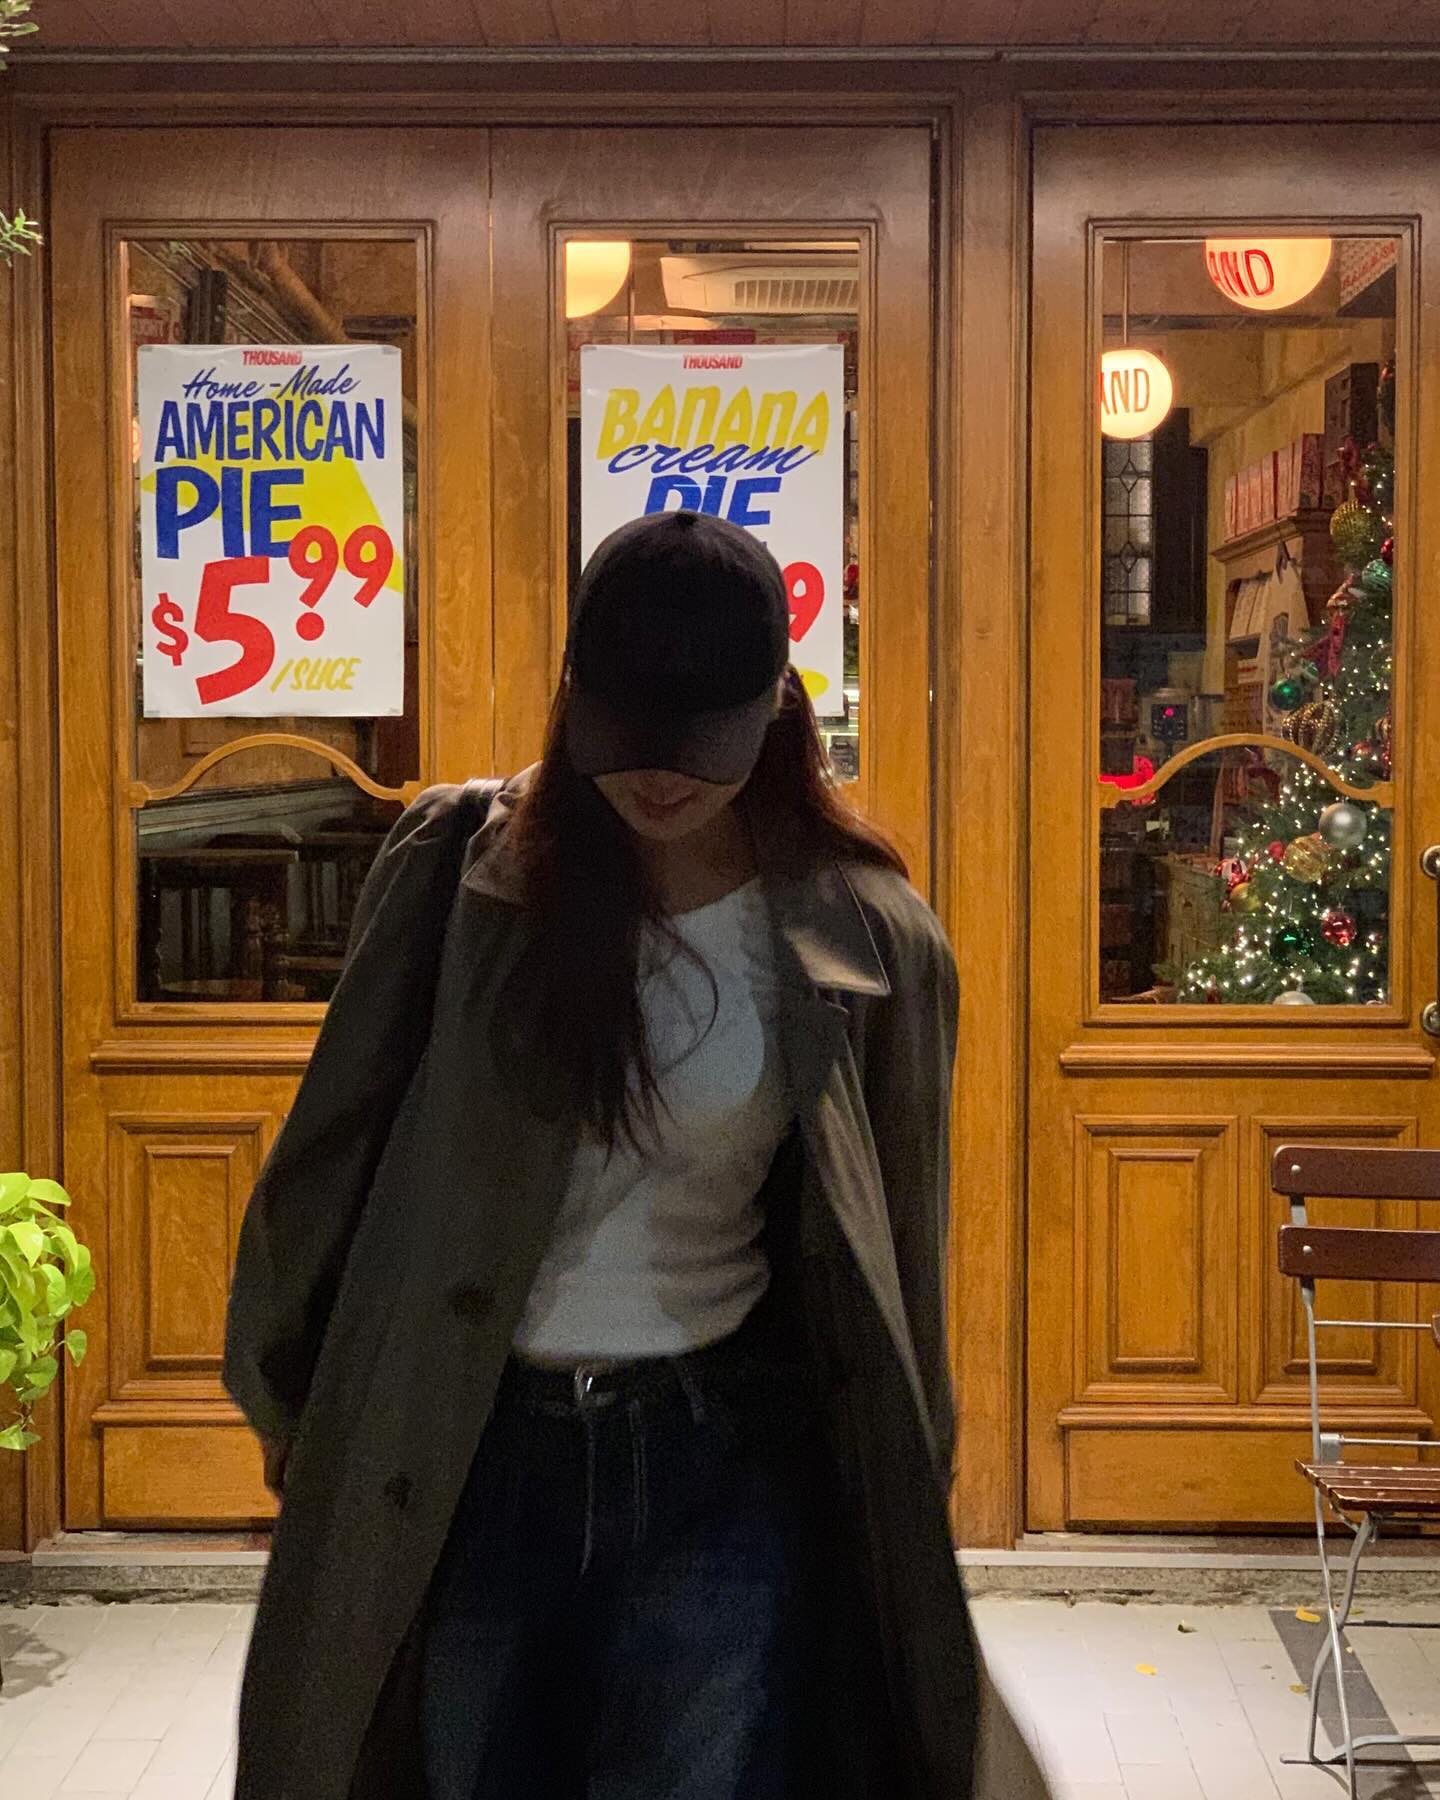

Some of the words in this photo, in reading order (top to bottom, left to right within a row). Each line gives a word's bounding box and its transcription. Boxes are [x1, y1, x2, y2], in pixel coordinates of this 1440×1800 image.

[242, 350, 303, 366] THOUSAND
[682, 354, 743, 370] THOUSAND
[154, 398, 385, 463] AMERICAN
[596, 383, 830, 461] BANANA
[608, 443, 822, 475] cream
[156, 466, 304, 559] PIE
